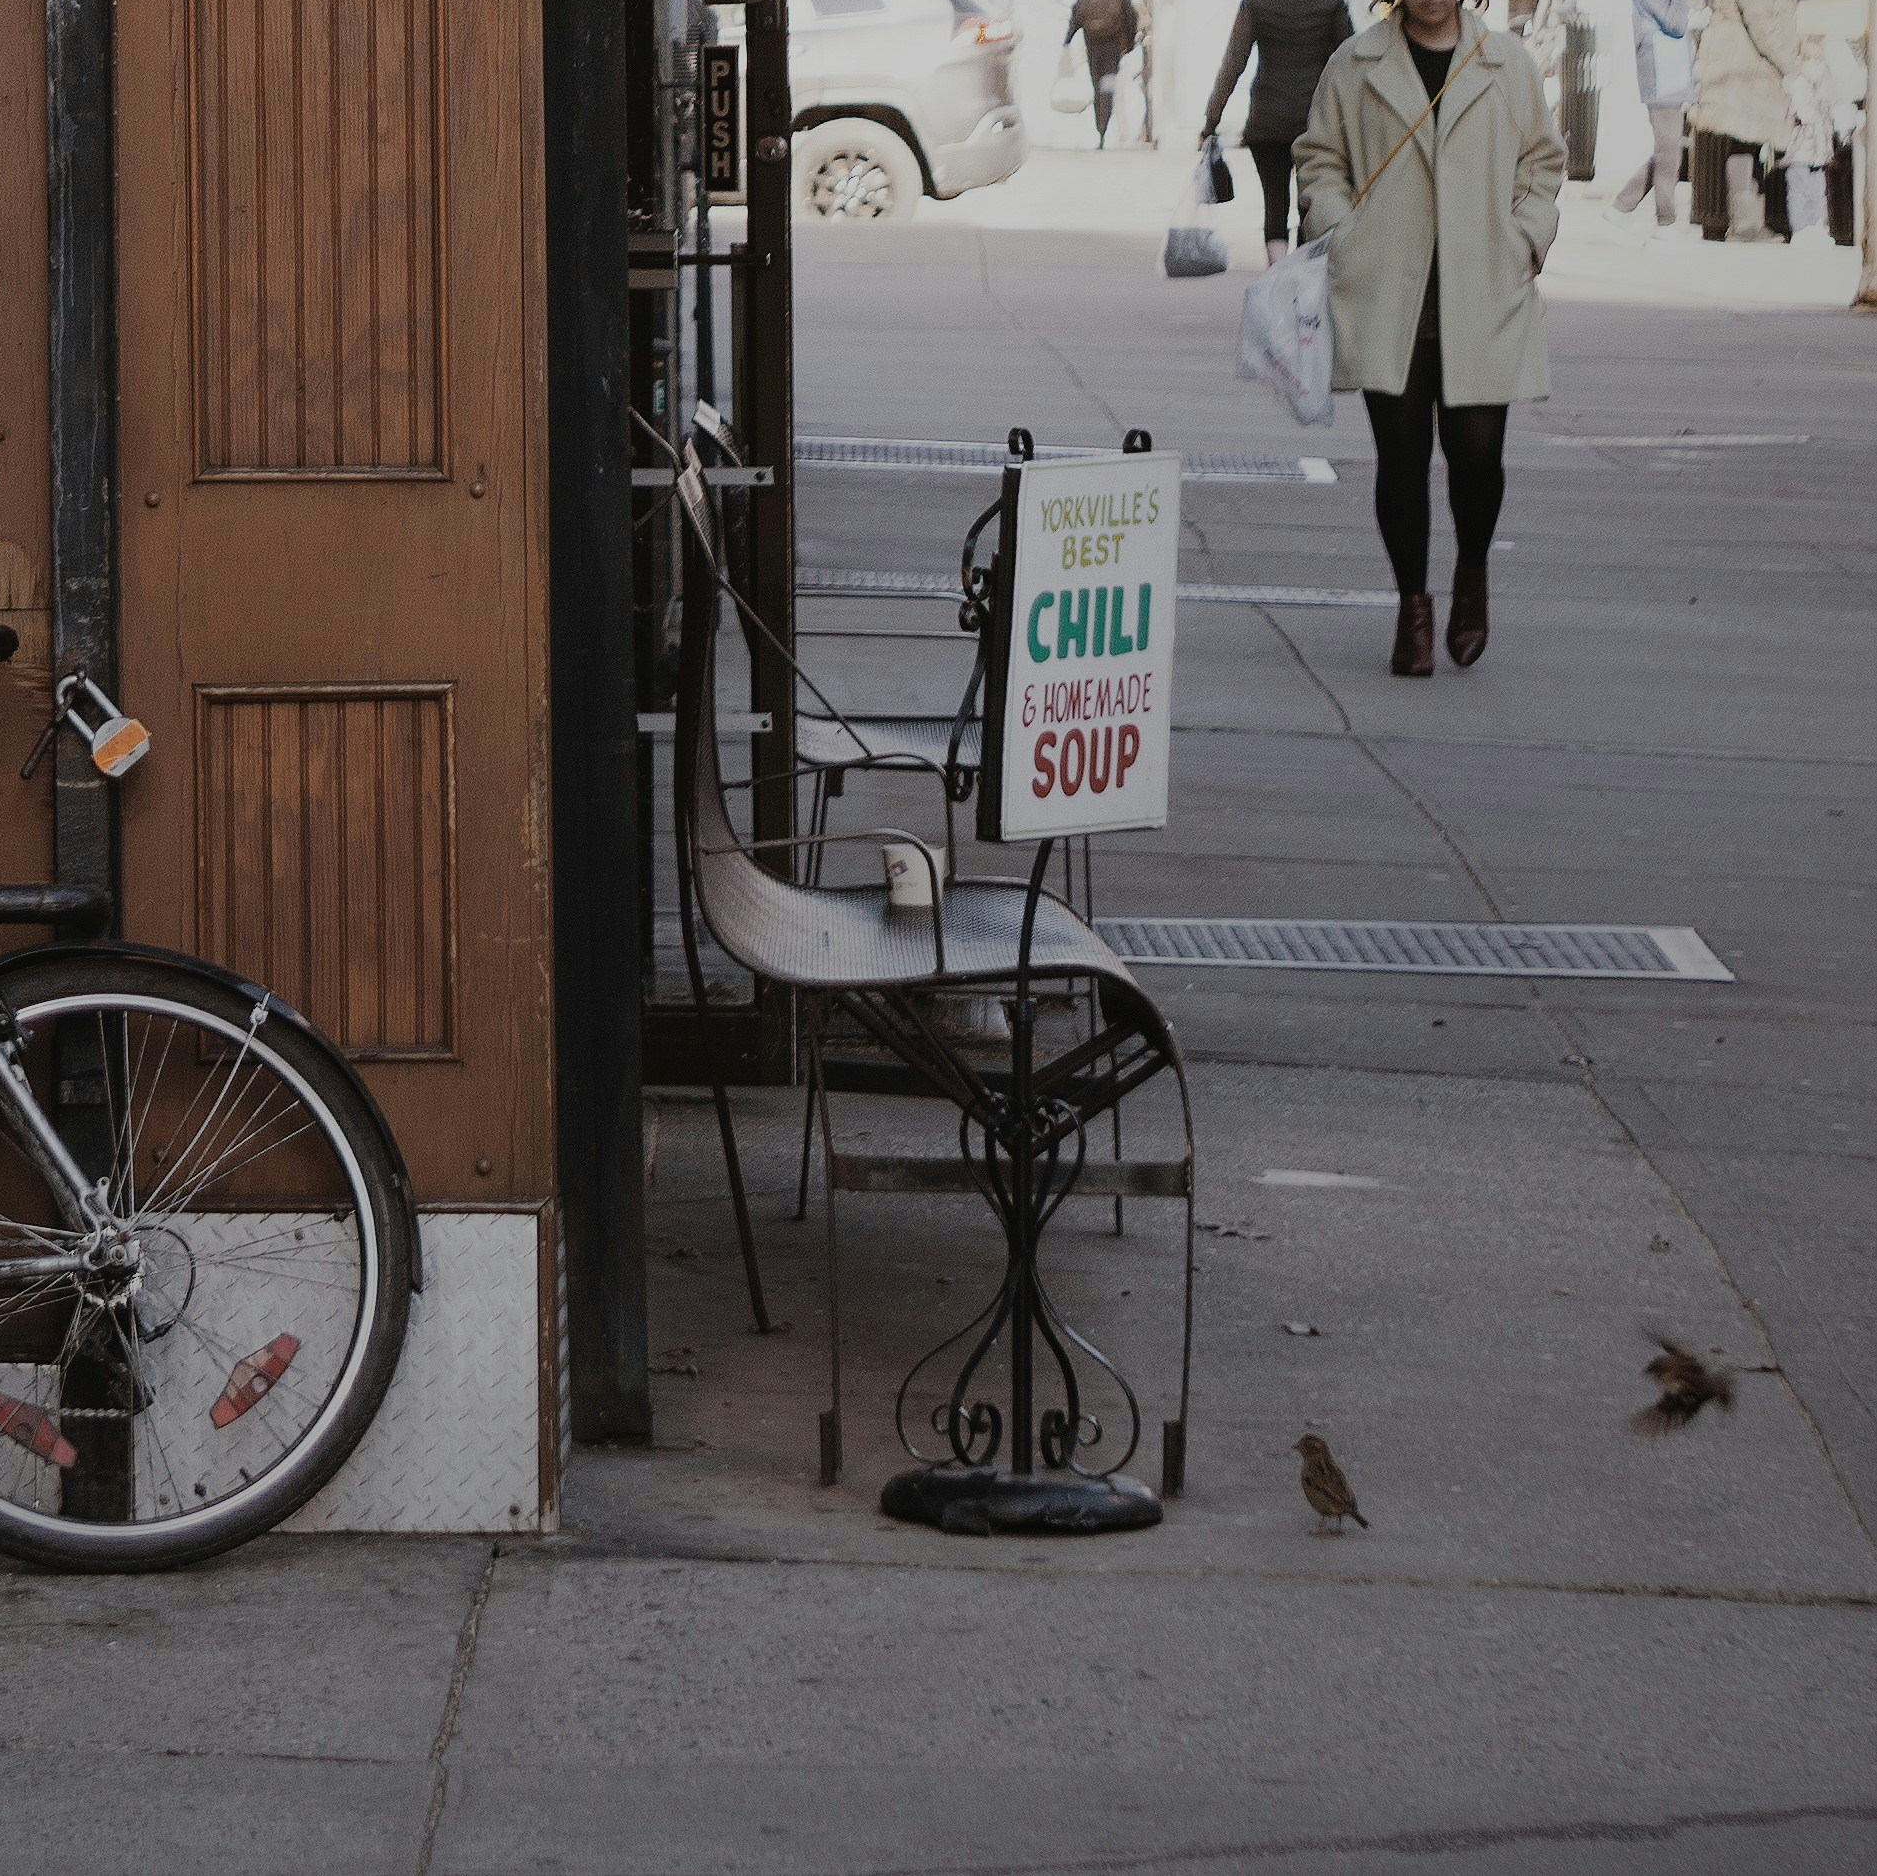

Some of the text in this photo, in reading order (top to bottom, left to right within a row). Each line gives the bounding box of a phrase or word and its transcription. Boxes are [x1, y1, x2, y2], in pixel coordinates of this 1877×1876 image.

[711, 60, 731, 178] PUSH
[1040, 484, 1160, 532] YORKVILLE'S
[1062, 534, 1124, 570] BEST
[1027, 583, 1152, 663] CHILI
[1023, 673, 1152, 727] & HOMEMADE
[1032, 723, 1140, 799] SOUP
